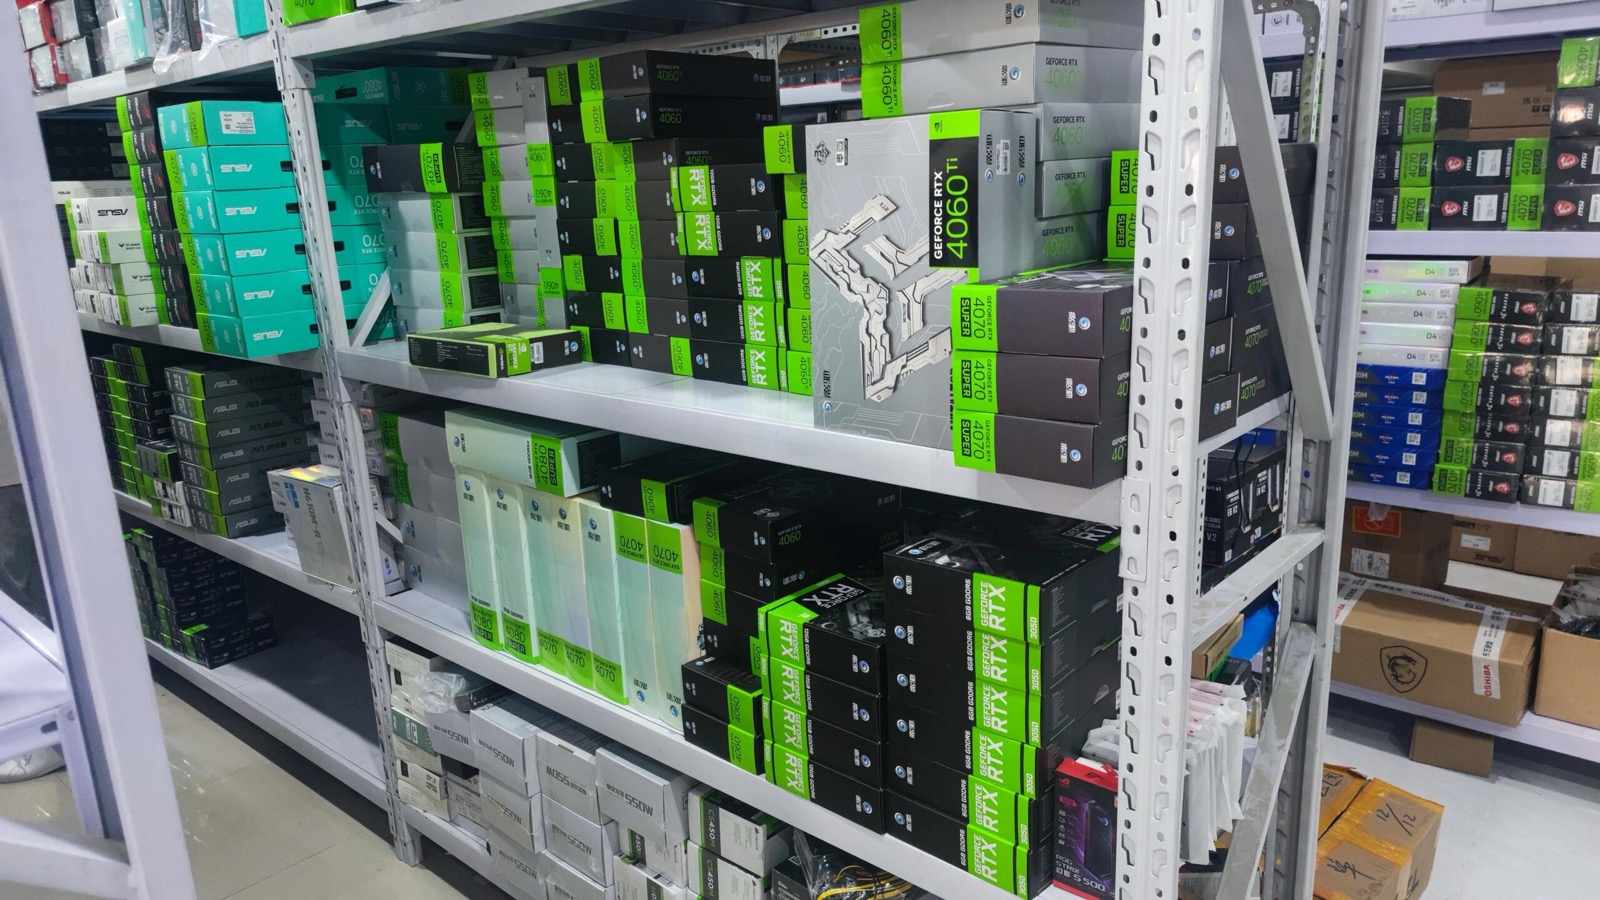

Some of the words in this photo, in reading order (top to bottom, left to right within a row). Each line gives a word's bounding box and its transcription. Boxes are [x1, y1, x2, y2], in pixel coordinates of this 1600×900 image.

[1046, 57, 1067, 66] GEFORCE
[1068, 58, 1078, 67] RTX
[592, 106, 600, 134] 4060
[660, 115, 682, 125] 4060
[1053, 116, 1075, 124] GEFORCE
[1076, 116, 1086, 124] RTX
[1411, 107, 1422, 133] 4070
[1422, 108, 1431, 132] SUPER
[778, 131, 786, 162] 4060
[220, 164, 252, 172] ASUS
[946, 157, 958, 173] Ti
[1408, 153, 1419, 178] 4070
[1419, 153, 1428, 177] SUPER
[1521, 149, 1533, 175] 4070
[1532, 149, 1543, 175] SUPER
[1580, 152, 1588, 169] msi
[689, 169, 703, 206] RTX
[934, 171, 943, 197] RTX
[1055, 173, 1076, 181] GEFORCE
[1077, 172, 1086, 180] RTX
[1121, 160, 1129, 194] SUPER
[800, 178, 808, 209] 4060
[97, 208, 129, 218] ASUS
[225, 206, 257, 216] ASUS
[946, 174, 968, 259] 4060
[1405, 198, 1416, 223] 4070
[1416, 198, 1425, 222] SUPER
[1517, 195, 1529, 221] 4070
[1528, 196, 1539, 221] SUPER
[1577, 201, 1585, 216] msi
[695, 214, 709, 251] RTX
[705, 214, 713, 251] GEFORCE
[797, 225, 805, 255] 4060
[934, 199, 943, 259] GEFORCE
[1042, 228, 1064, 237] GEFORCE
[1065, 227, 1074, 235] RTX
[1117, 215, 1125, 248] SUPER
[235, 248, 267, 258] ASUS
[751, 261, 763, 297] RTX
[802, 270, 810, 300] 4060
[1247, 280, 1262, 296] 4070
[243, 290, 275, 300] ASUS
[1473, 291, 1484, 314] 4060
[753, 306, 766, 341] RTX
[961, 299, 971, 336] SUPER
[973, 297, 985, 340] 4070
[252, 330, 284, 341] ASUS
[1244, 332, 1260, 348] 4070
[754, 350, 767, 385] RTX
[962, 360, 971, 397] SUPER
[973, 360, 985, 401] 4070
[213, 379, 238, 389] ASUS
[1240, 384, 1256, 400] 4070
[212, 403, 238, 413] ASUS
[216, 427, 240, 437] ASUS
[962, 420, 971, 456] SUPER
[973, 420, 984, 460] 4070
[220, 449, 244, 460] ASUS
[538, 445, 547, 485] 4080
[548, 450, 556, 485] SUPER
[226, 473, 250, 483] ASUS
[229, 495, 252, 505] ASUS
[235, 518, 258, 529] ASUS
[705, 511, 713, 538] 4060
[620, 535, 644, 552] 4070
[1207, 532, 1217, 542] V2
[653, 544, 678, 562] 4070
[802, 583, 857, 605] RTX
[821, 588, 864, 610] GEFORCE
[980, 581, 989, 626] GEFORCE
[989, 582, 1006, 631] RTX
[779, 619, 794, 660] RTX
[791, 622, 800, 661] GEFORCE
[566, 650, 585, 668] 4070
[982, 633, 990, 678] GEFORCE
[990, 634, 1007, 683] RTX
[595, 665, 616, 683] 4070
[781, 664, 796, 705] RTX
[793, 667, 801, 706] GEFORCE
[1031, 669, 1039, 691] 3050
[983, 685, 991, 728] GEFORCE
[990, 686, 1008, 733] RTX
[783, 708, 798, 748] RTX
[794, 712, 803, 749] GEFORCE
[785, 752, 800, 794] RTX
[987, 738, 1003, 784] RTX
[796, 757, 804, 794] GEFORCE
[625, 794, 654, 816] 550W
[975, 784, 983, 825] GEFORCE
[982, 786, 998, 833] RTX
[708, 809, 716, 848] CS450M
[981, 836, 997, 882] RTX
[1056, 854, 1072, 866] ROG
[1056, 860, 1080, 874] STRIX
[706, 859, 714, 897] CS450M
